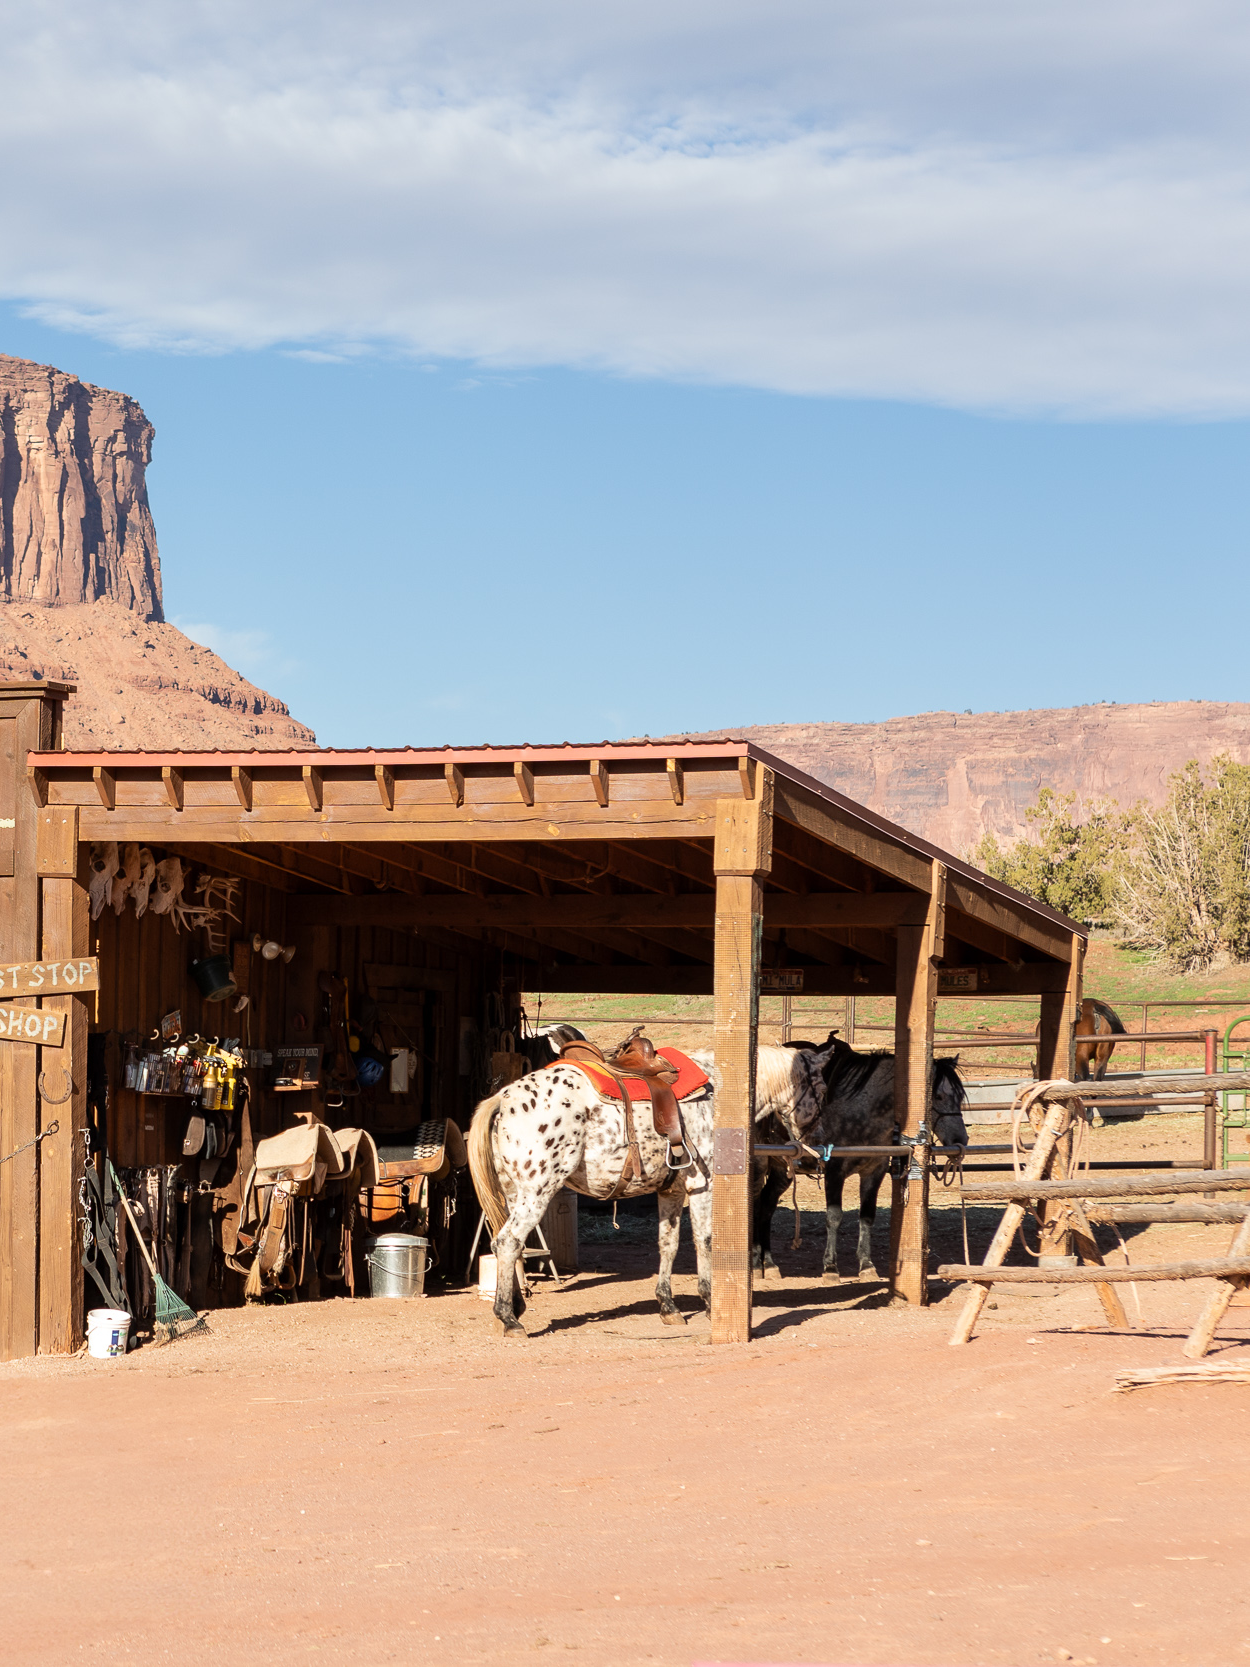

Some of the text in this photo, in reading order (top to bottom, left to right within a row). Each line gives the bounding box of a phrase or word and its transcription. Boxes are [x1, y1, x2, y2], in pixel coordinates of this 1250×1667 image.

[28, 962, 92, 987] STOP
[778, 975, 801, 986] MULA
[940, 975, 969, 986] MULES
[277, 1049, 292, 1057] SPEAK
[293, 1048, 305, 1057] YOUR
